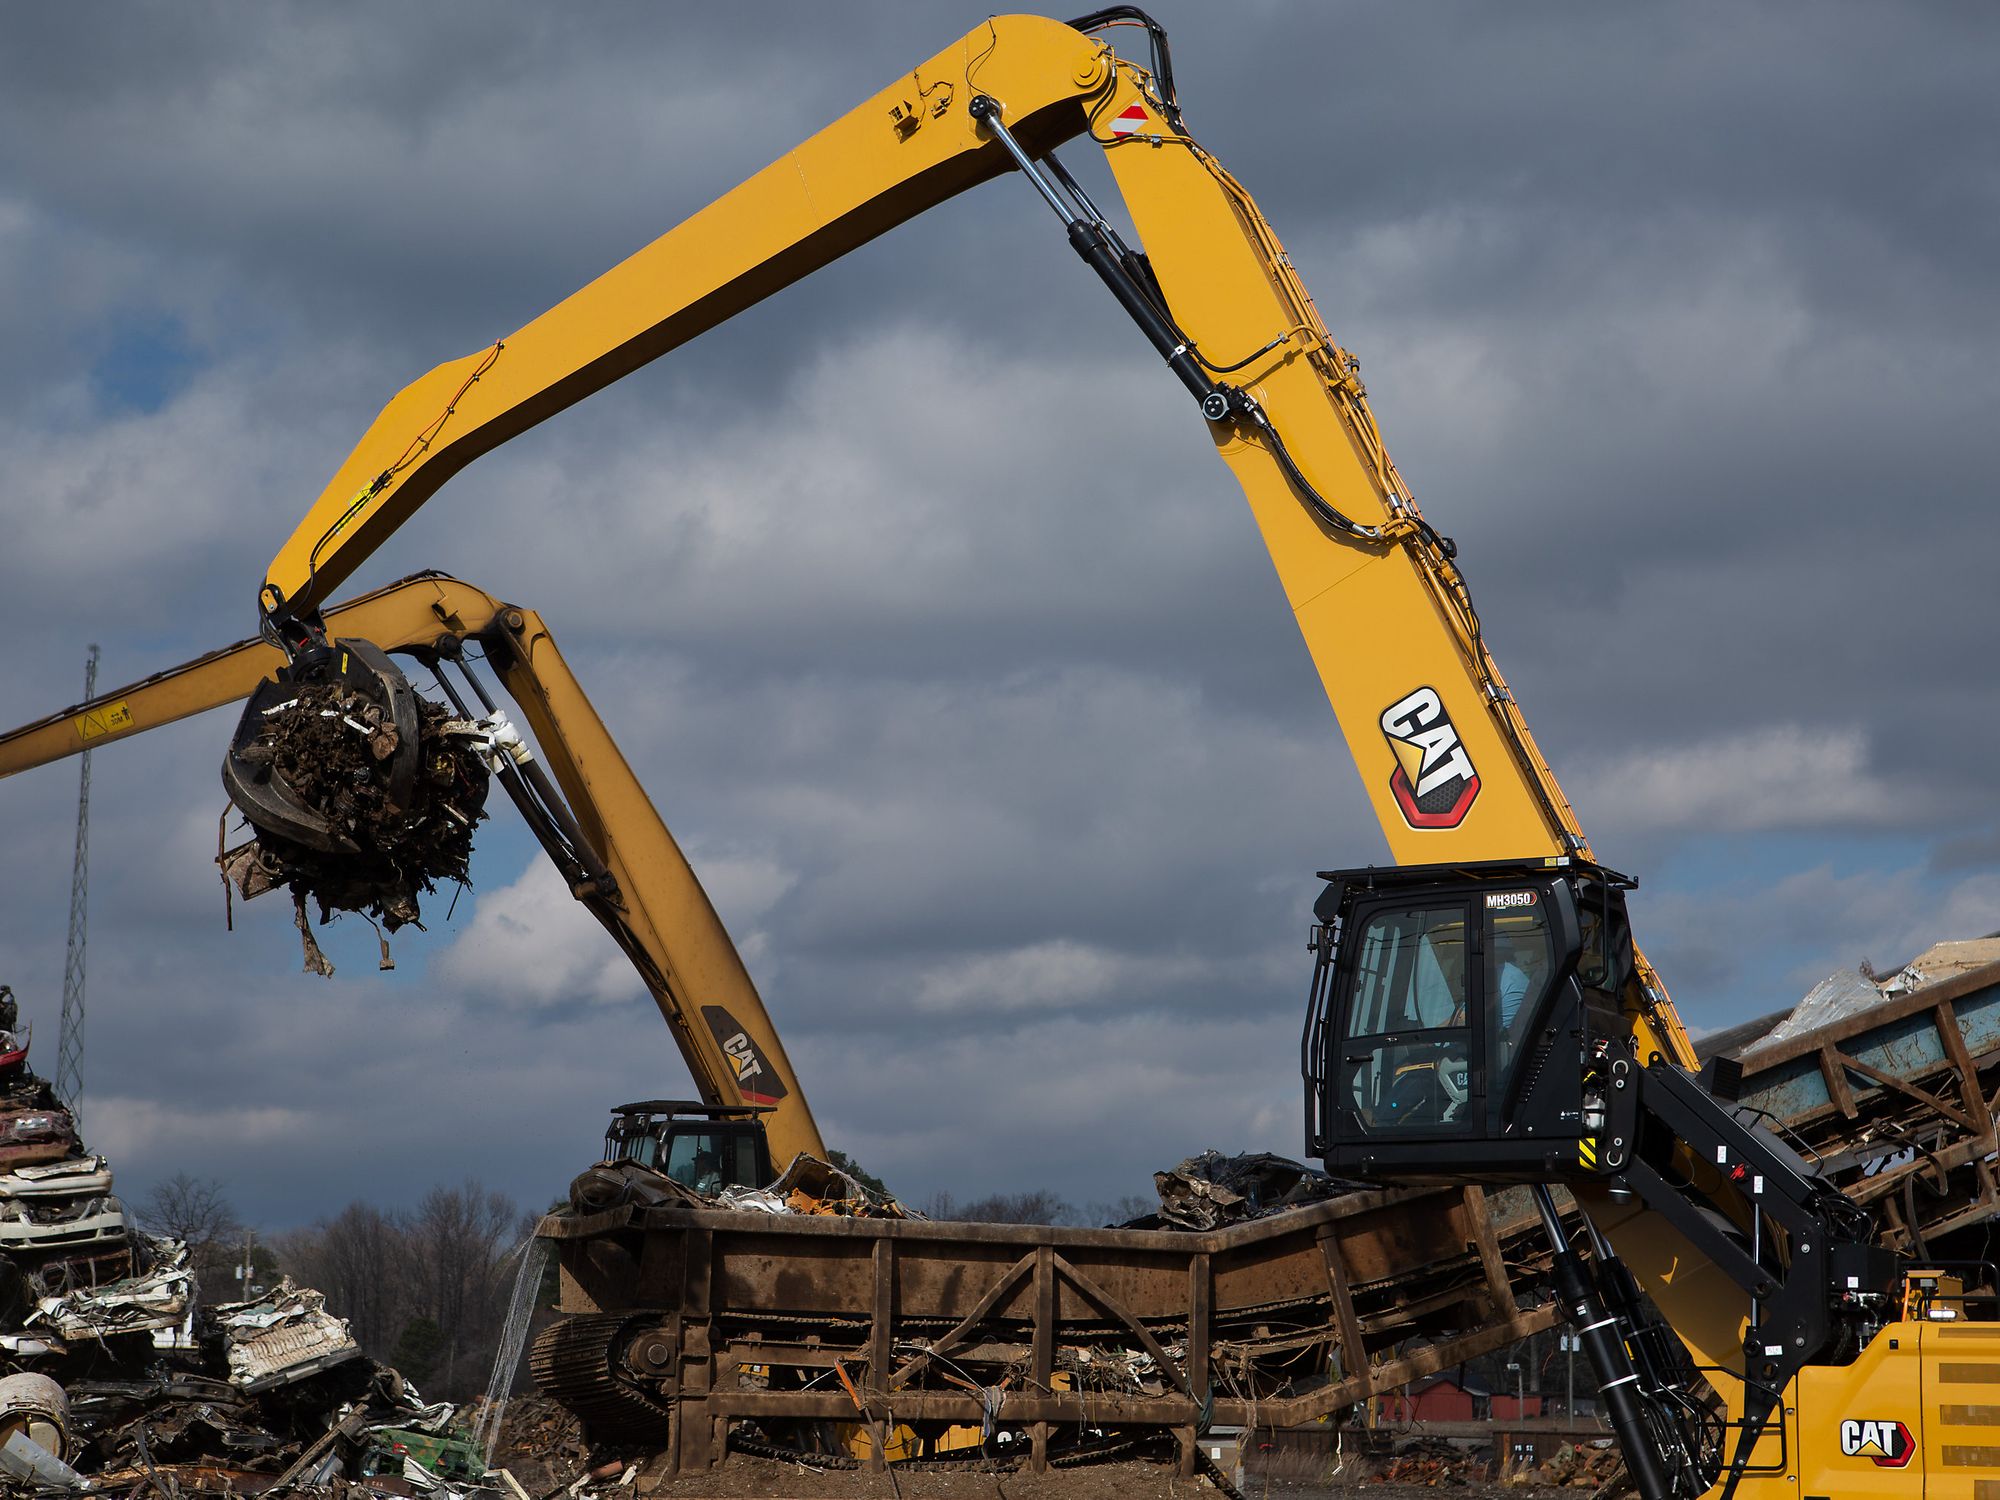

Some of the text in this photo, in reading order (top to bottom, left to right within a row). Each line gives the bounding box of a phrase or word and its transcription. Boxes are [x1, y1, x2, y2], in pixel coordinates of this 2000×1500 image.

[1382, 688, 1475, 797] CAT
[1486, 893, 1531, 907] MH3050
[723, 1032, 763, 1082] CAT
[1841, 1420, 1897, 1457] CAT
